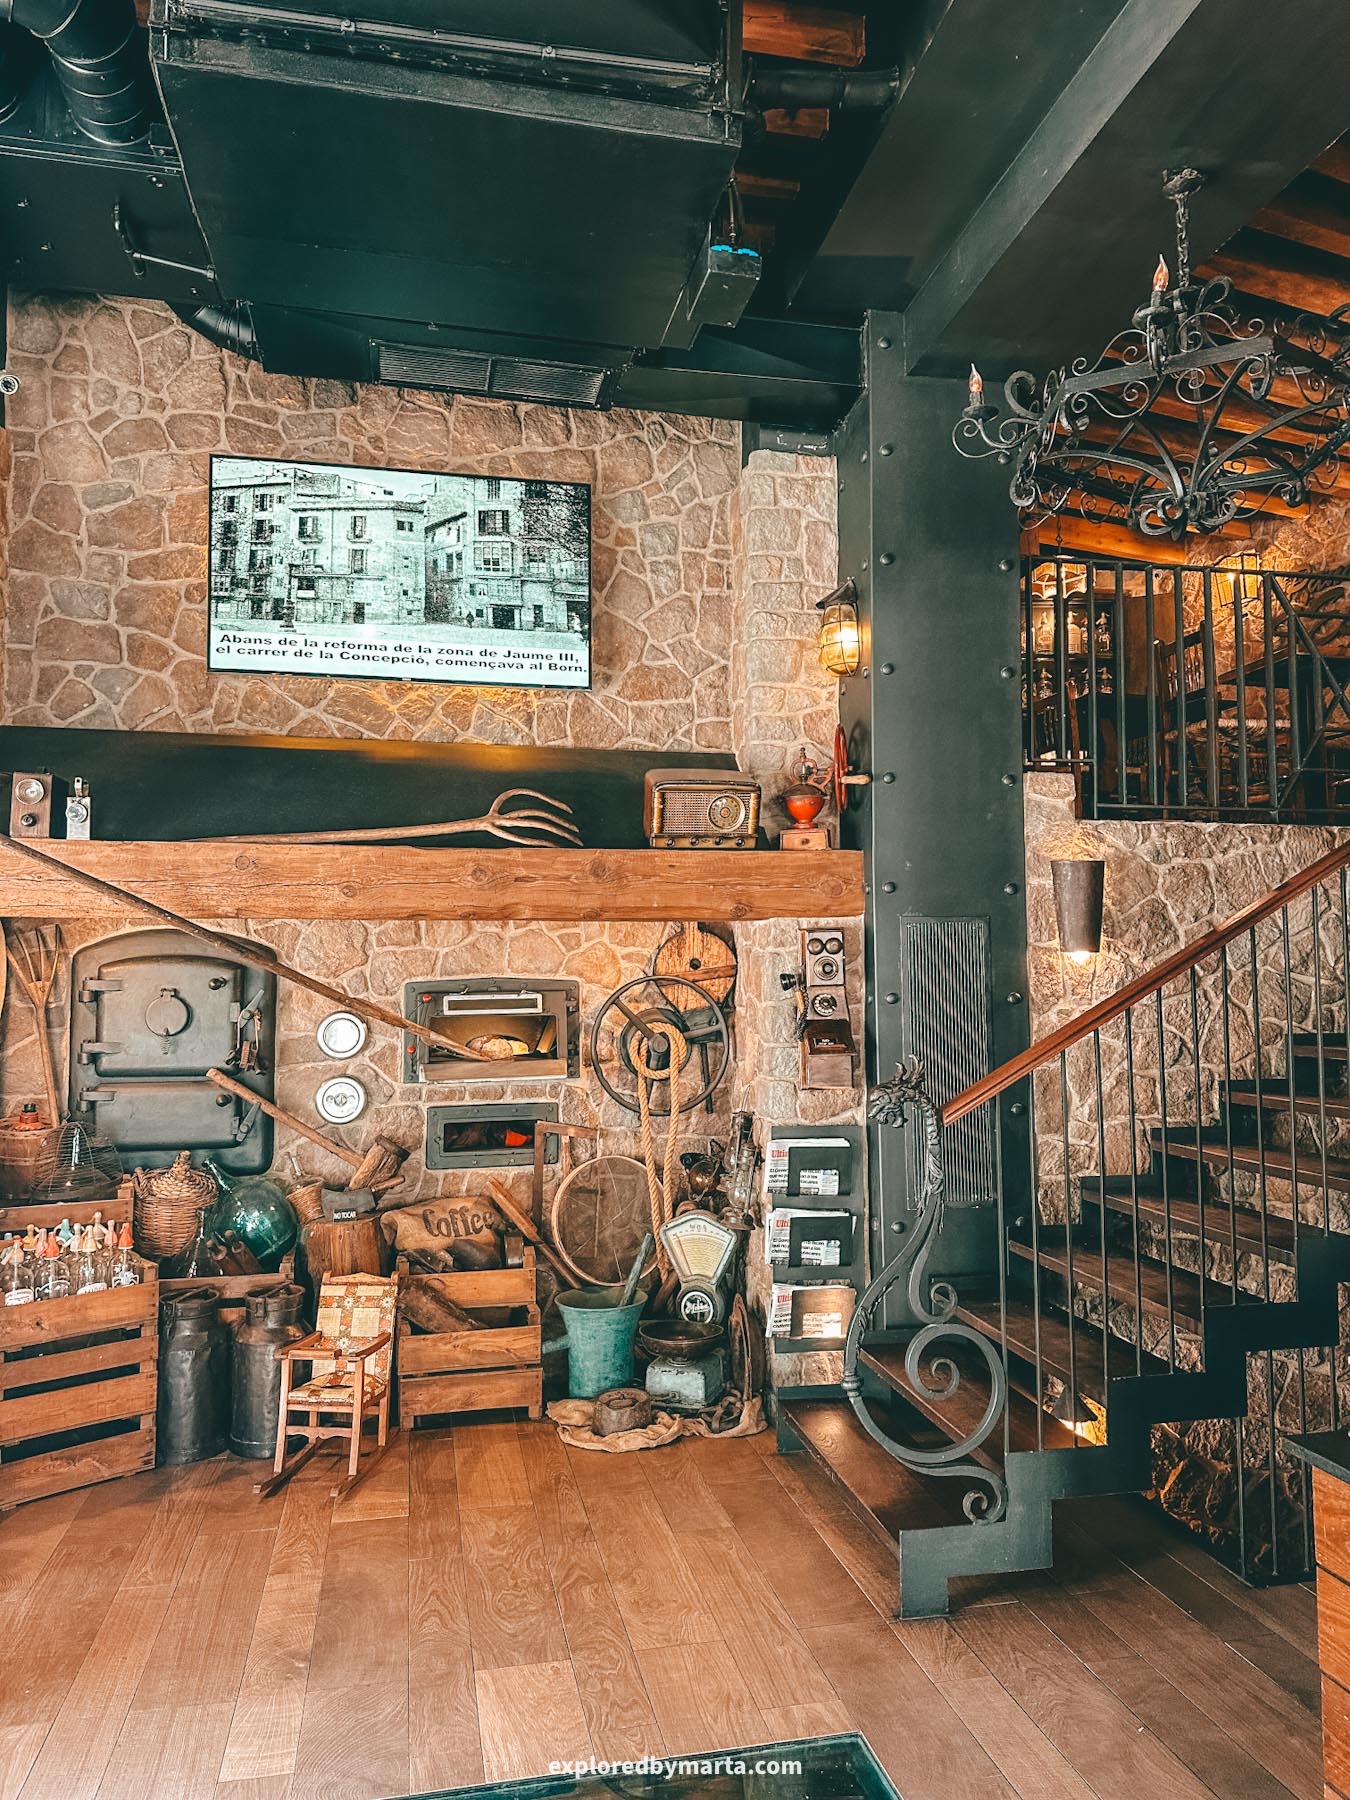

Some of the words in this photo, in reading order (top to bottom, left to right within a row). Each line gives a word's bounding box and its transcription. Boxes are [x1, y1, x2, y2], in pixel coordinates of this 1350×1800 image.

[215, 645, 231, 654] el
[237, 647, 288, 656] carrer
[294, 649, 313, 658] de
[319, 650, 334, 659] la
[340, 651, 430, 666] Concepció,
[435, 658, 524, 670] començava
[529, 662, 543, 670] al
[548, 662, 587, 673] Born.
[220, 634, 272, 645] Abans
[278, 637, 298, 646] de
[304, 638, 318, 647] la
[324, 640, 387, 651] reforma
[394, 644, 412, 653] de
[418, 645, 432, 653] la
[437, 648, 473, 656] zona
[479, 649, 498, 657] de
[503, 650, 553, 660] Jaume
[559, 653, 579, 663] III,
[771, 1149, 788, 1158] Ulti
[333, 1211, 341, 1219] NO
[422, 1205, 492, 1238] Coffee
